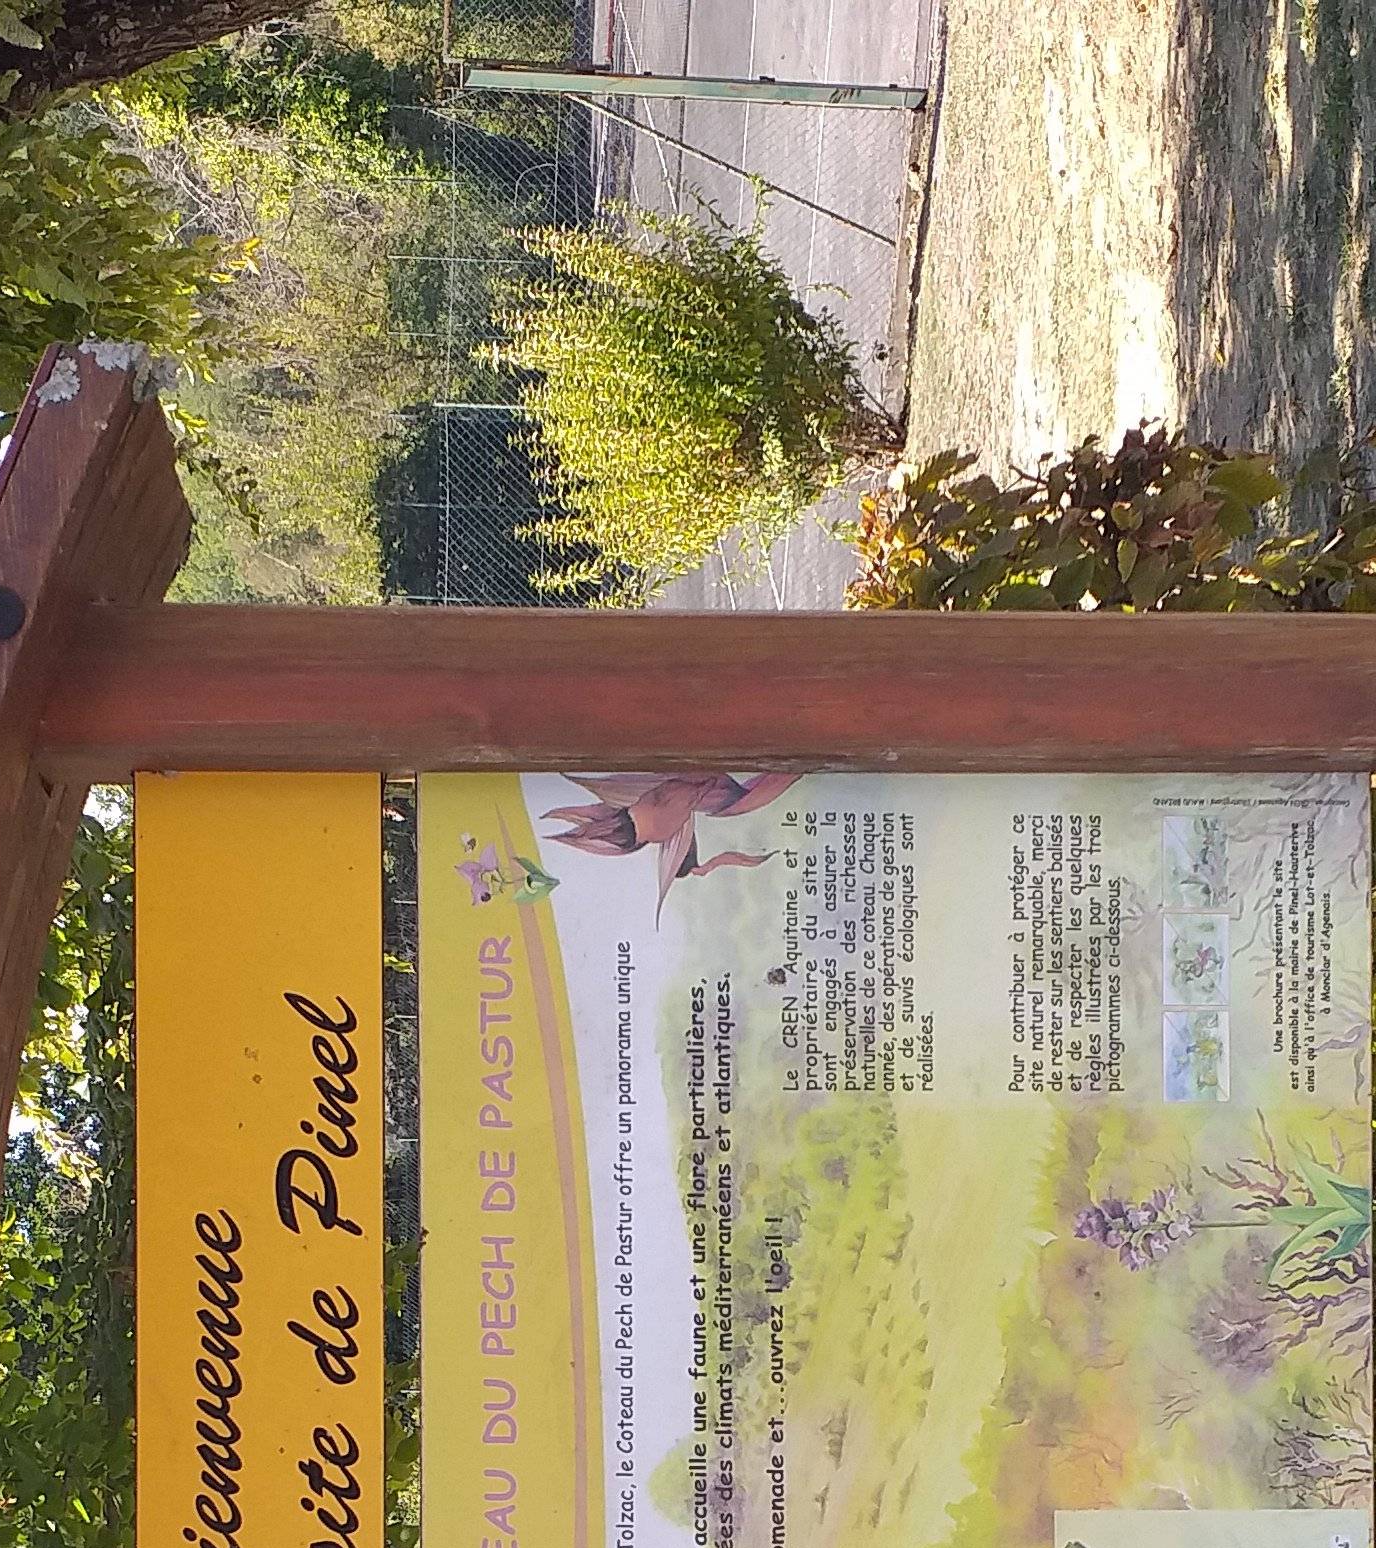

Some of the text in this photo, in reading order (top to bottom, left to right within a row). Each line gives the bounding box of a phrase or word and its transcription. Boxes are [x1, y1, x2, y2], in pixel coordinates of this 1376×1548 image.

[614, 941, 636, 1004] unique
[781, 812, 802, 1091] Le CREN Aquitaine et le
[801, 812, 822, 1091] propriétaire du site se
[819, 812, 842, 1092] sont engagés à assurer la
[839, 812, 862, 1091] préservation des richesses
[858, 813, 880, 1091] naturelles de ce coteau. Chaque
[878, 813, 899, 1092] année, des opérations de gestion
[897, 813, 919, 1091] et de suivis écologiques sont
[1008, 814, 1029, 1091] Pour contribuer à protéger ce
[1027, 815, 1048, 1092] site naturel remarquable, merci
[1046, 814, 1064, 1092] de rester sur les sentiers balisés
[1065, 815, 1087, 1091] et de respecter les quelques
[1083, 815, 1106, 1091] règles illustrées par les trois
[1102, 876, 1125, 1092] pictogrammes ci-dessous.
[1272, 859, 1286, 1053] Une brochure présentant le site
[1287, 822, 1302, 1090] est disponible à la mairie de Pinel-Hauterive
[1320, 956, 1331, 1002] Monclar
[478, 936, 515, 1129] PASTUR
[618, 1011, 636, 1104] panorama
[713, 972, 735, 1114] atlantiques.
[916, 1011, 934, 1091] réalisées.
[1320, 1007, 1331, 1015] à
[686, 978, 711, 1140] particulières,
[275, 993, 361, 1236] Pinel
[618, 1111, 632, 1133] un
[715, 1125, 731, 1152] et
[479, 1152, 517, 1212] DE
[613, 1140, 633, 1195] offre
[686, 1152, 707, 1212] flore
[615, 1202, 632, 1266] Pastur
[693, 1222, 706, 1264] une
[712, 1164, 733, 1351] méditerranéens
[764, 1235, 783, 1293] l'oeil
[479, 1235, 517, 1358] PECH
[614, 1272, 632, 1296] de
[614, 1303, 632, 1349] Pech
[690, 1275, 706, 1301] et
[287, 1286, 359, 1385] de
[614, 1355, 633, 1379] du
[688, 1313, 708, 1381] faune
[481, 1378, 518, 1445] DU
[616, 1386, 634, 1454] Coteau
[693, 1391, 707, 1432] une
[713, 1359, 735, 1449] climats
[616, 1460, 634, 1476] le
[688, 1444, 707, 1546] accueille
[714, 1460, 733, 1502] des
